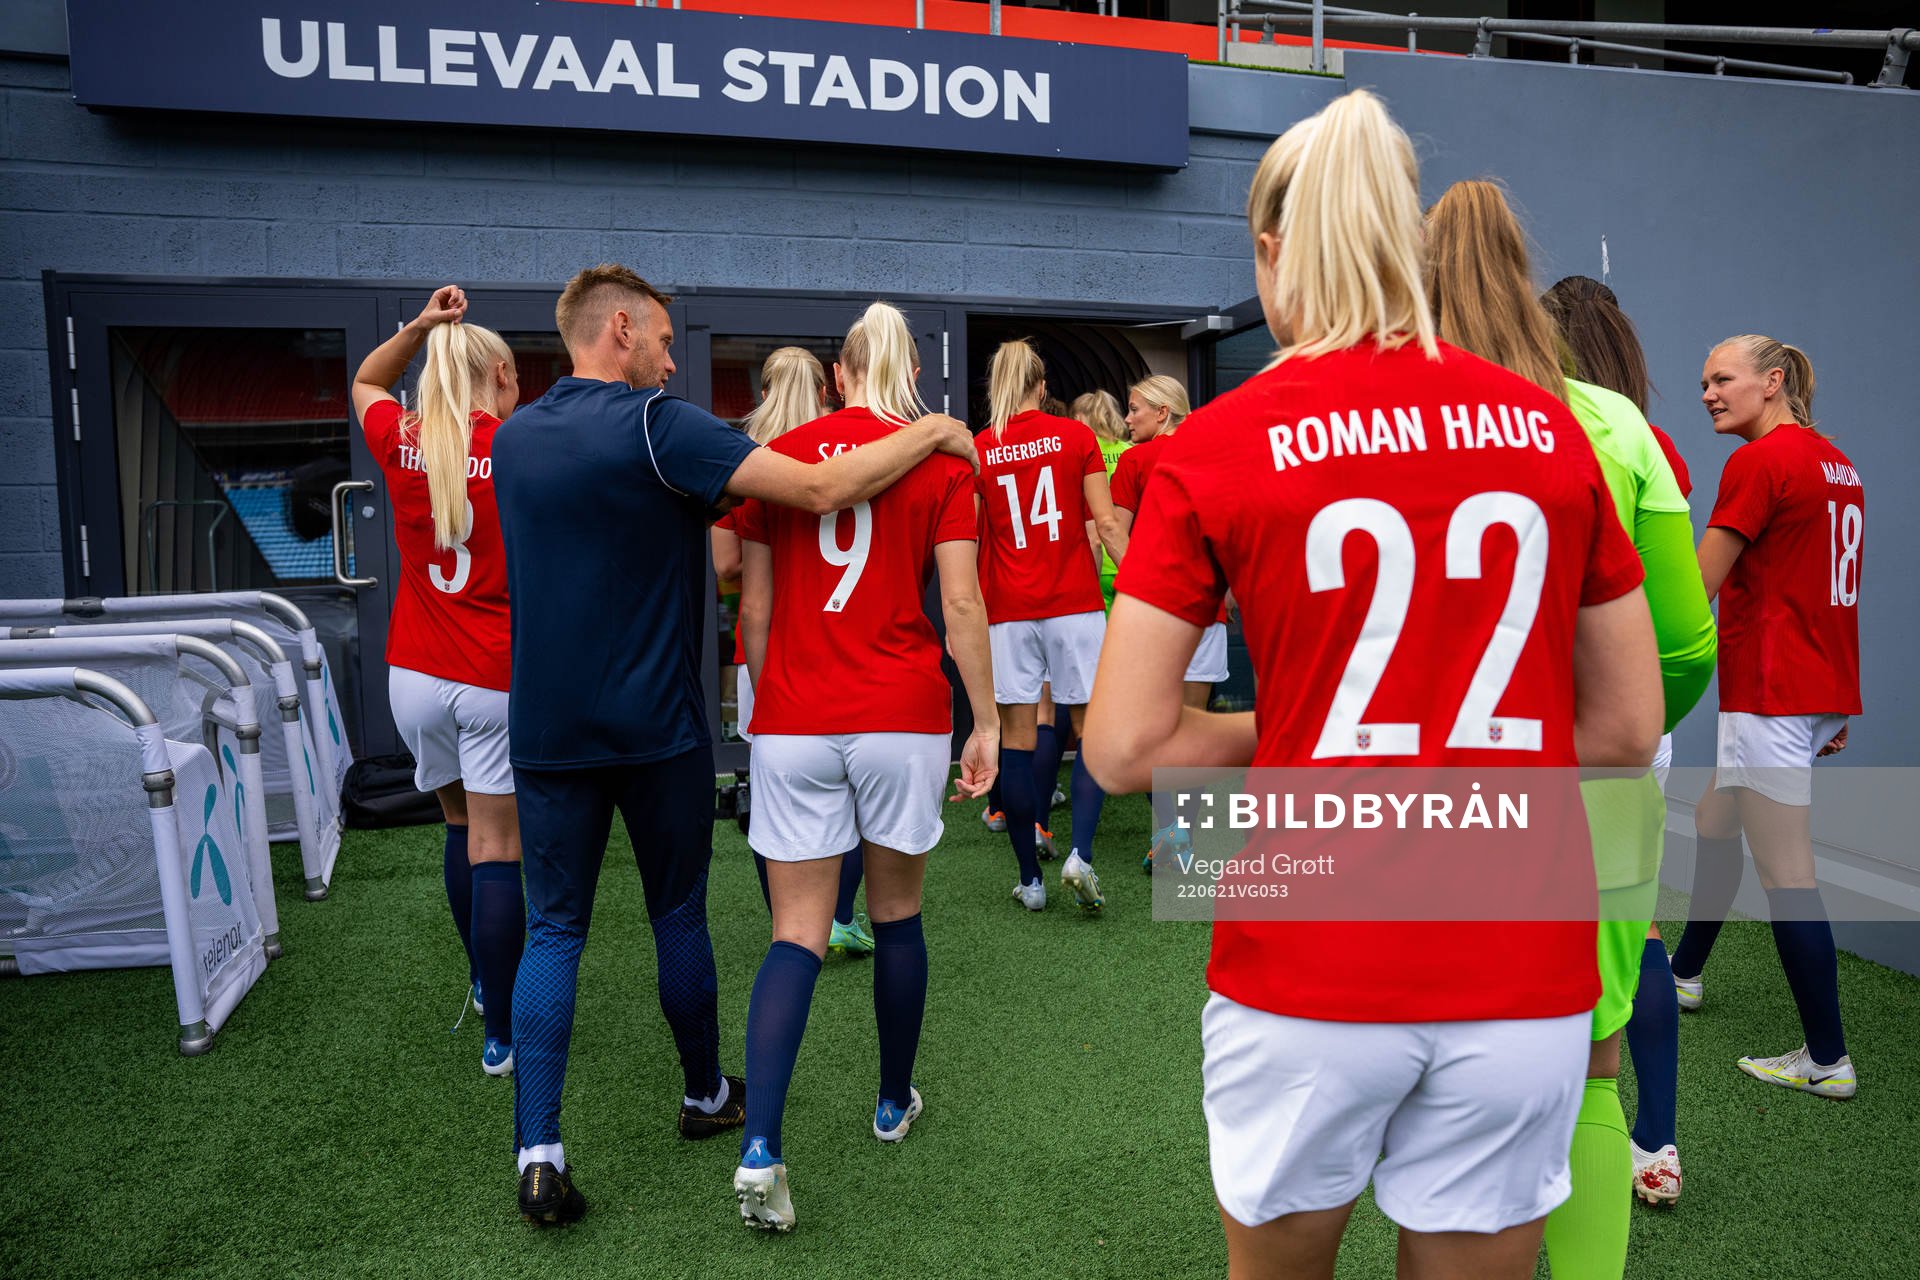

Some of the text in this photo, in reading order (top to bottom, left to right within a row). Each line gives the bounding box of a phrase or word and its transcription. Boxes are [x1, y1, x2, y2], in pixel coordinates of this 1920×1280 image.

[262, 18, 1051, 123] ULLEVAAL STADION
[985, 436, 1062, 466] HEGERBERG
[1268, 404, 1555, 471] ROMAN HAUG
[428, 498, 474, 594] 3
[997, 465, 1063, 549] 14
[1828, 500, 1863, 607] 18
[818, 502, 872, 613] 9
[1305, 491, 1549, 759] 22
[203, 921, 242, 977] telenor
